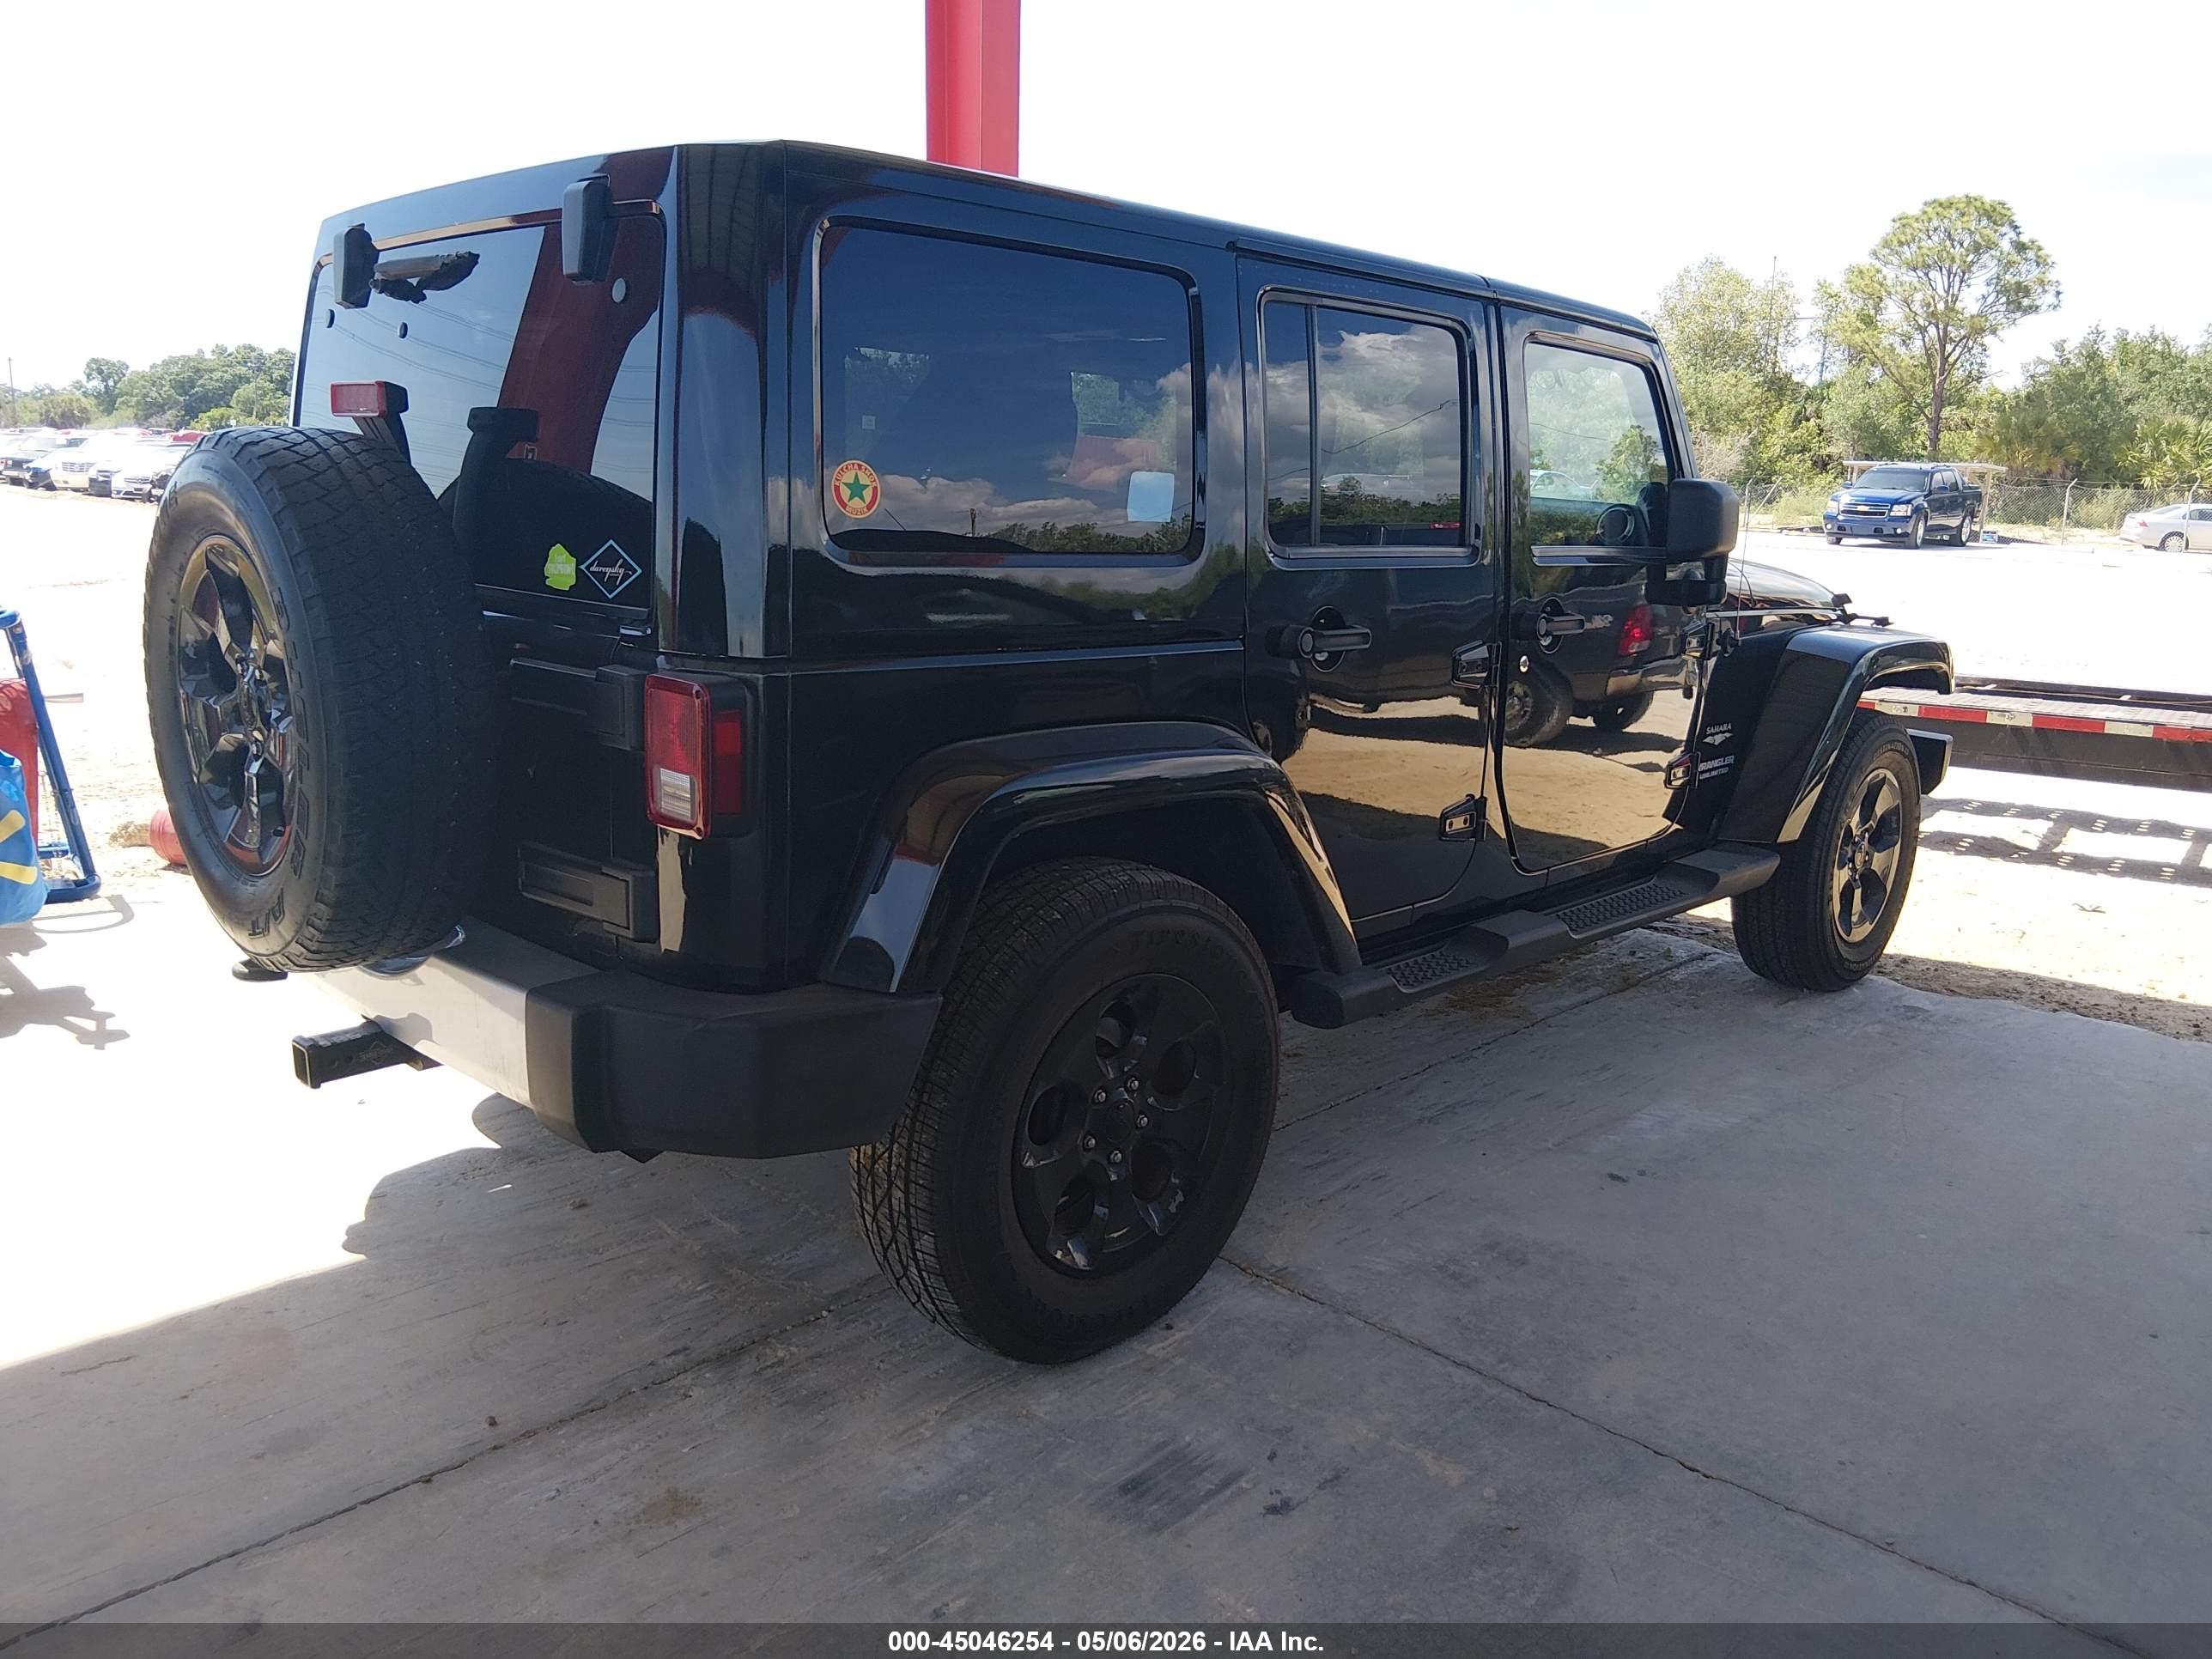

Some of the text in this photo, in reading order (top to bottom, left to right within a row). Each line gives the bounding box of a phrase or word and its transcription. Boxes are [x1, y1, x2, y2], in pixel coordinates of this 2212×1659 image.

[834, 463, 878, 488] KULCHA SHOK
[845, 505, 869, 516] MUZIK
[1705, 722, 1732, 735] SAHARA
